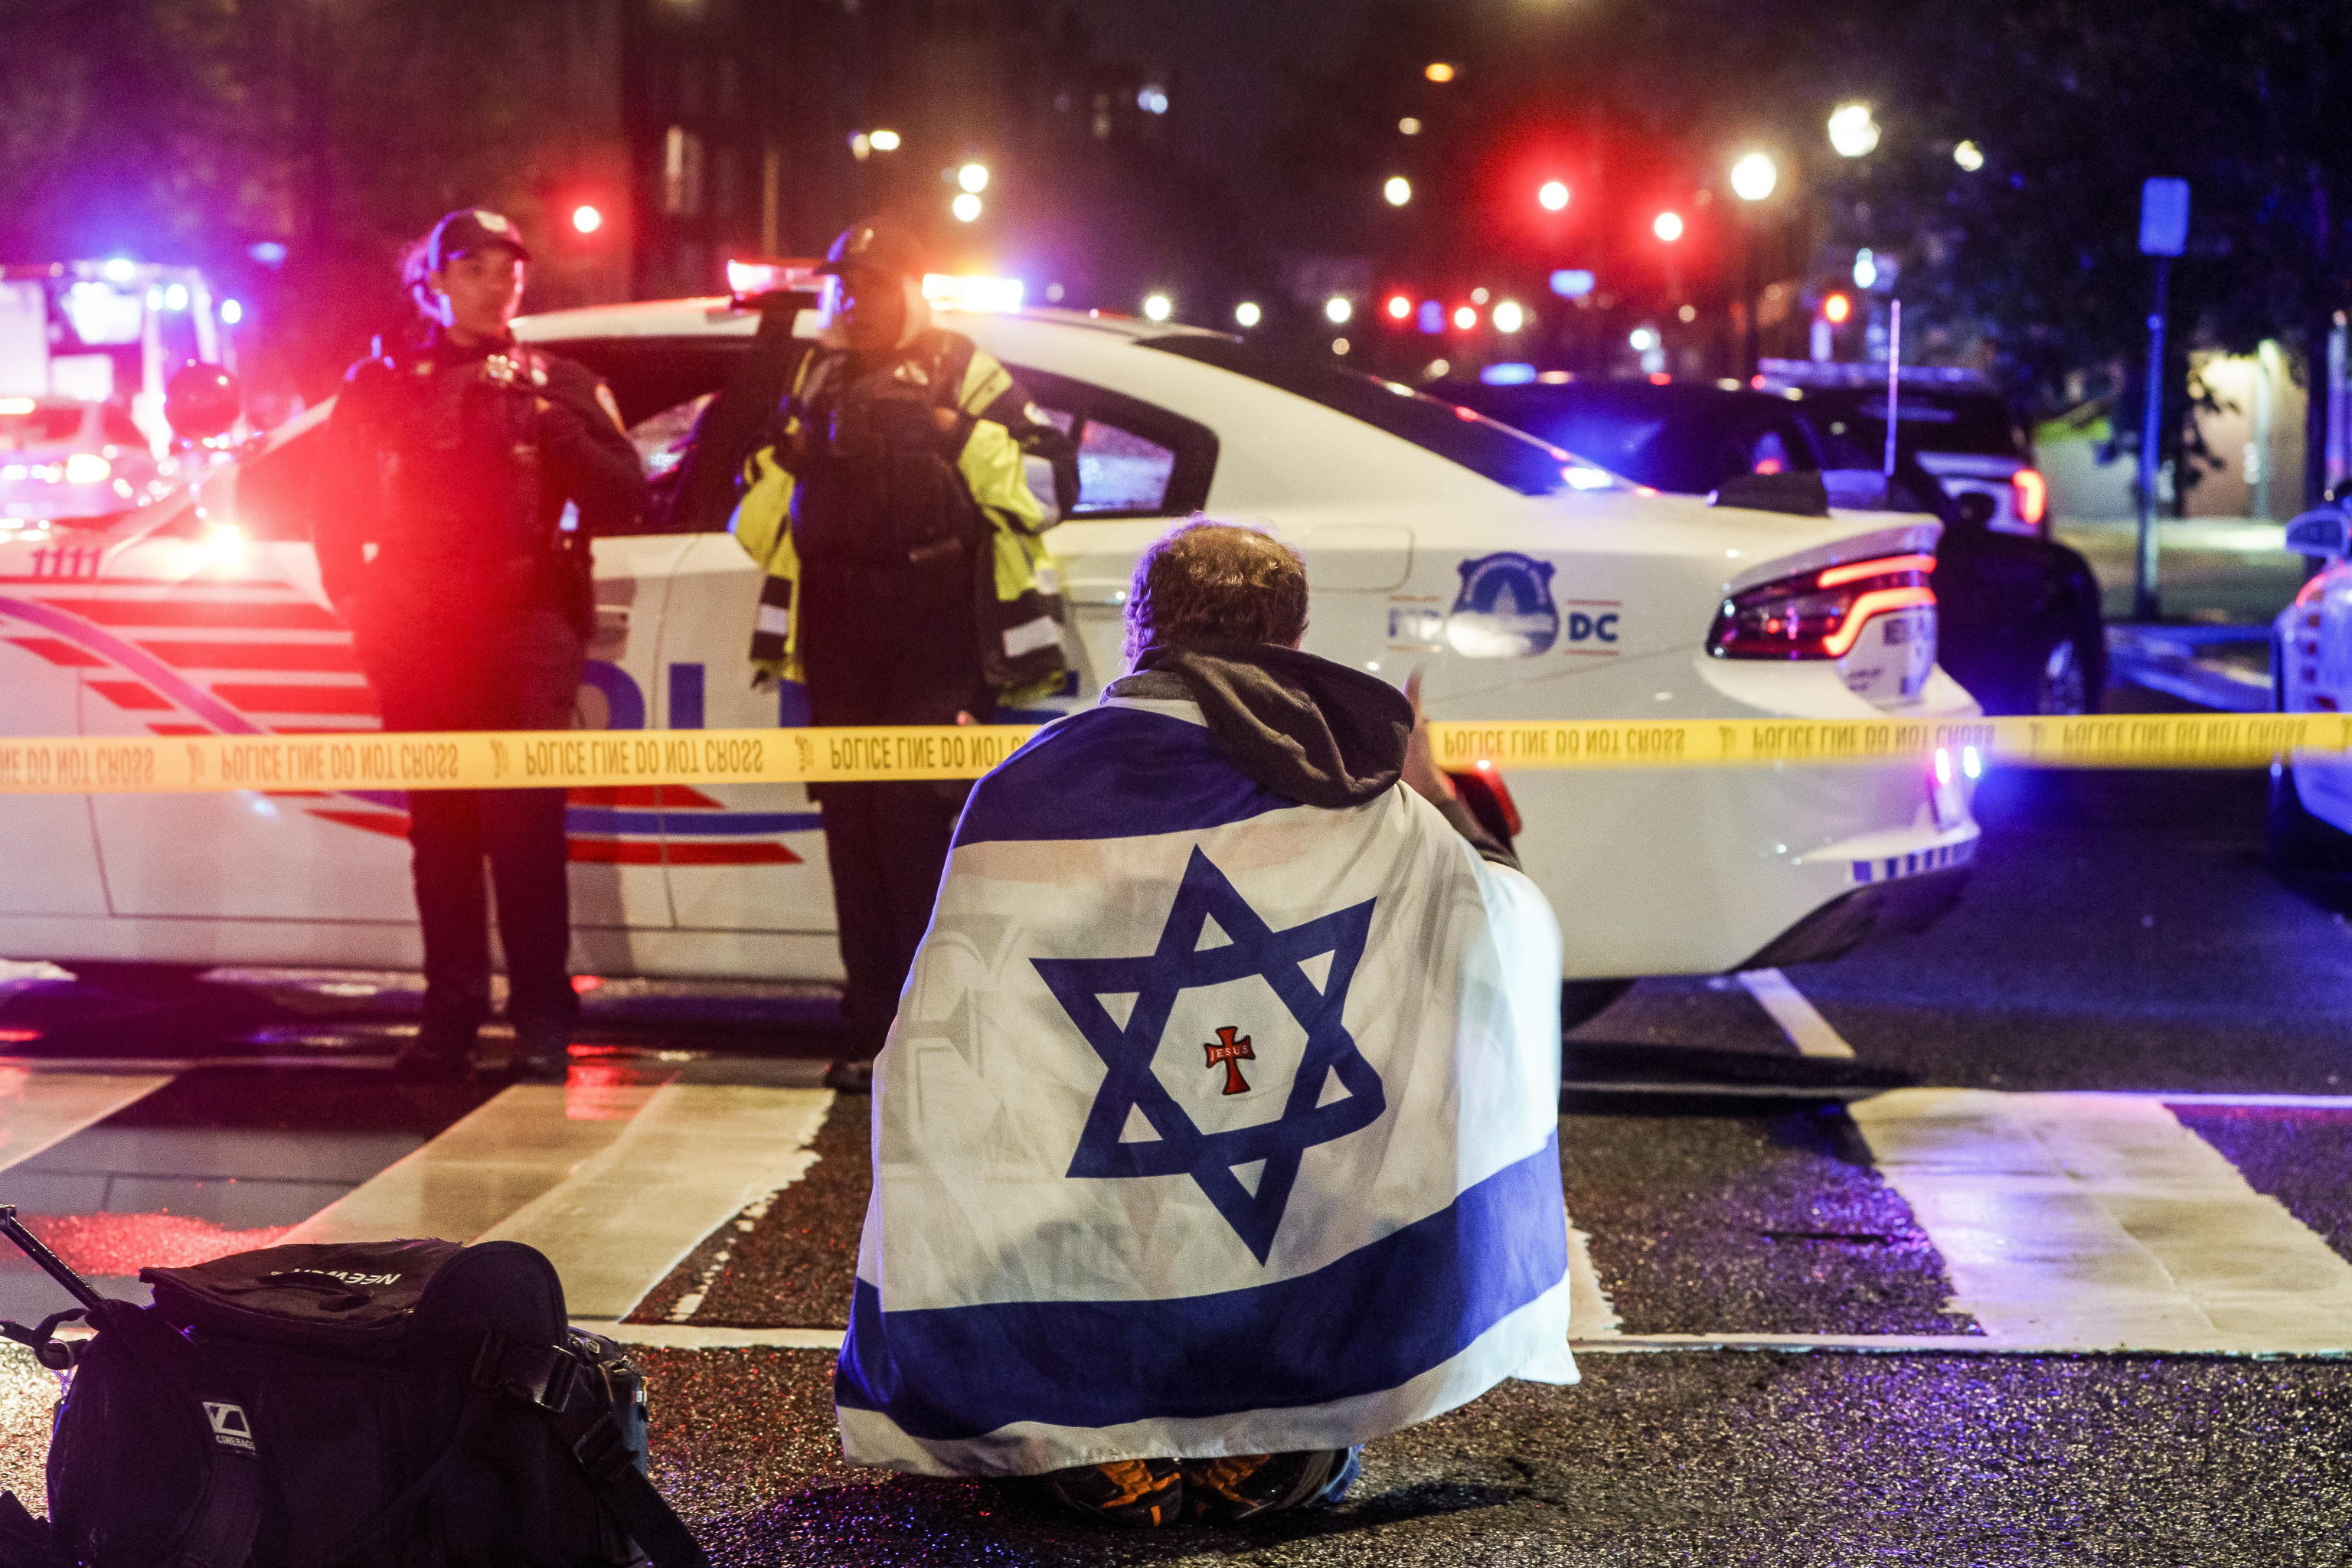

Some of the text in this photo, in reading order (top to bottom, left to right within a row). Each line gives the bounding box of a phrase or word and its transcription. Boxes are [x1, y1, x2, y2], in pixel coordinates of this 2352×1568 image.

[31, 547, 102, 577] 1111
[1568, 612, 1619, 642] DC
[1210, 1045, 1249, 1061] JESUS
[289, 1269, 402, 1285] NEEW
